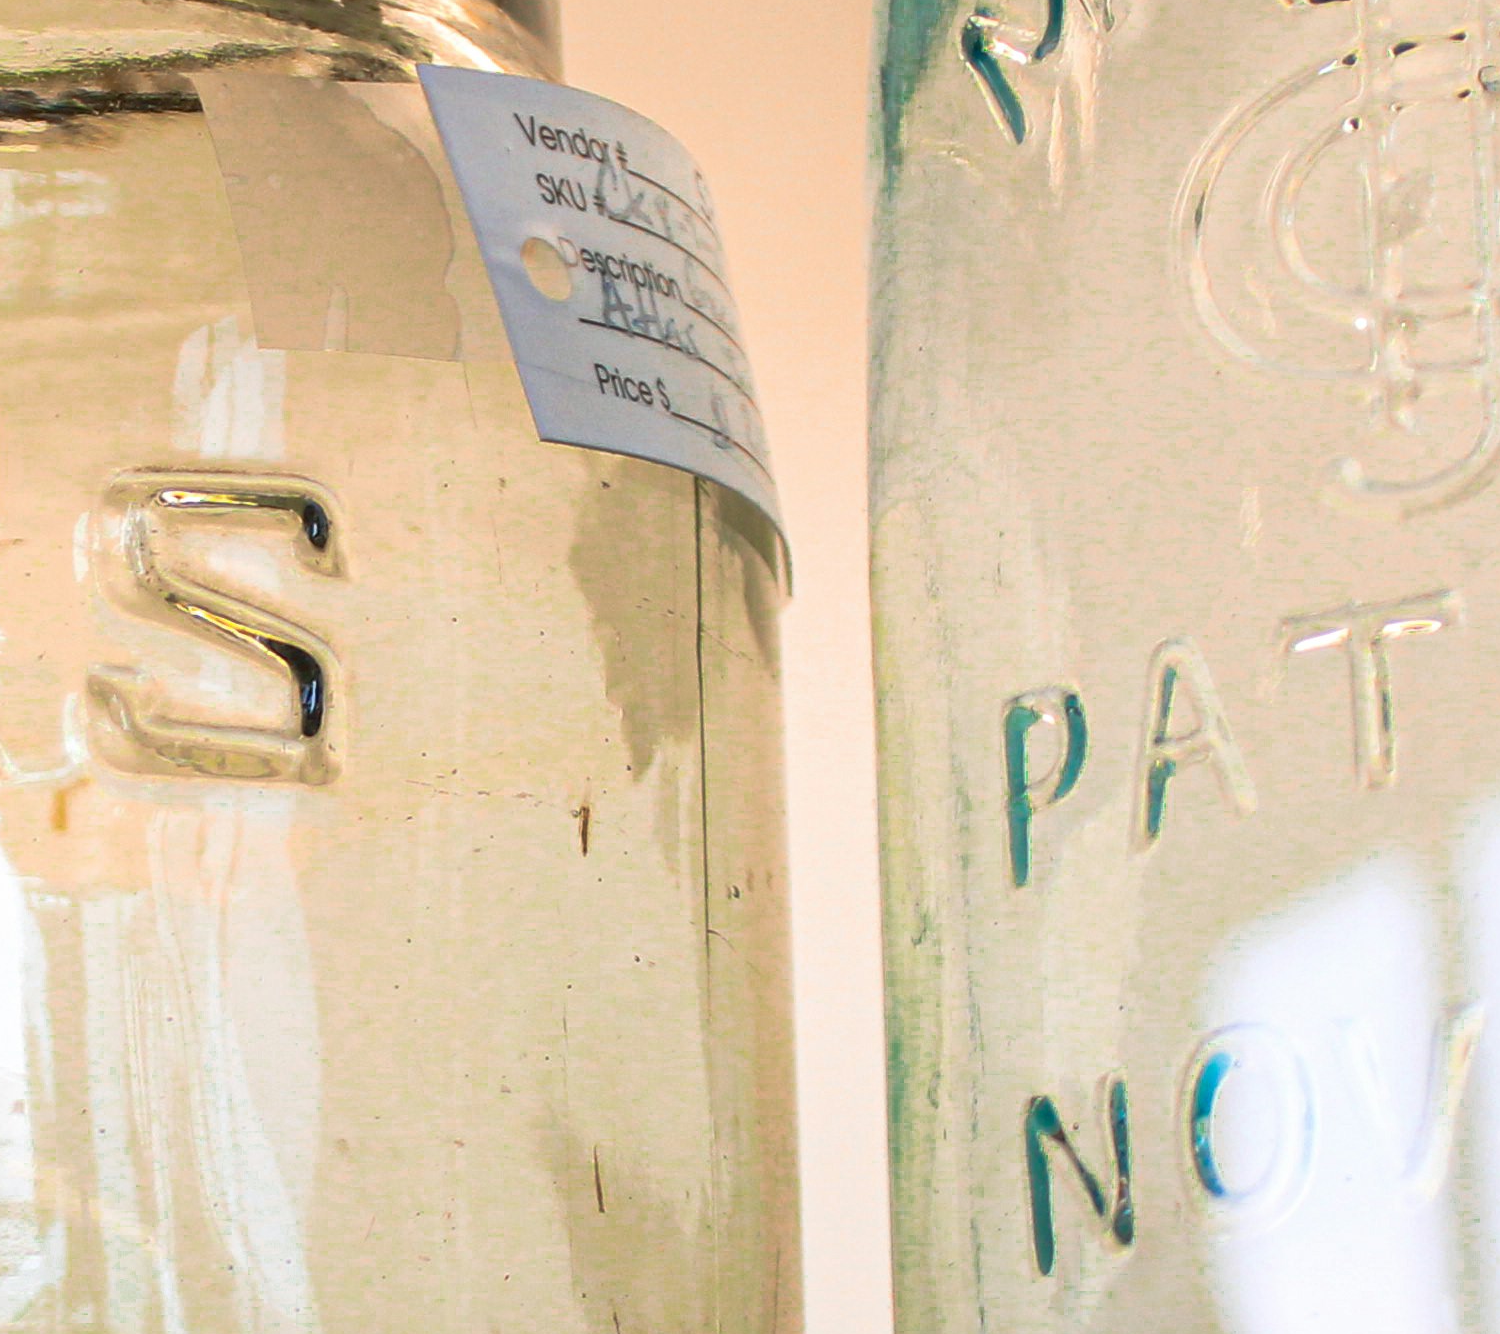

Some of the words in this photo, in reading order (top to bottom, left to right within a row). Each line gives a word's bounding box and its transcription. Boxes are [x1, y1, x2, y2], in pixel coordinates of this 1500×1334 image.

[513, 113, 612, 164] Vendor
[535, 173, 589, 214] SKU
[556, 235, 684, 304] Description
[593, 363, 654, 405] Price
